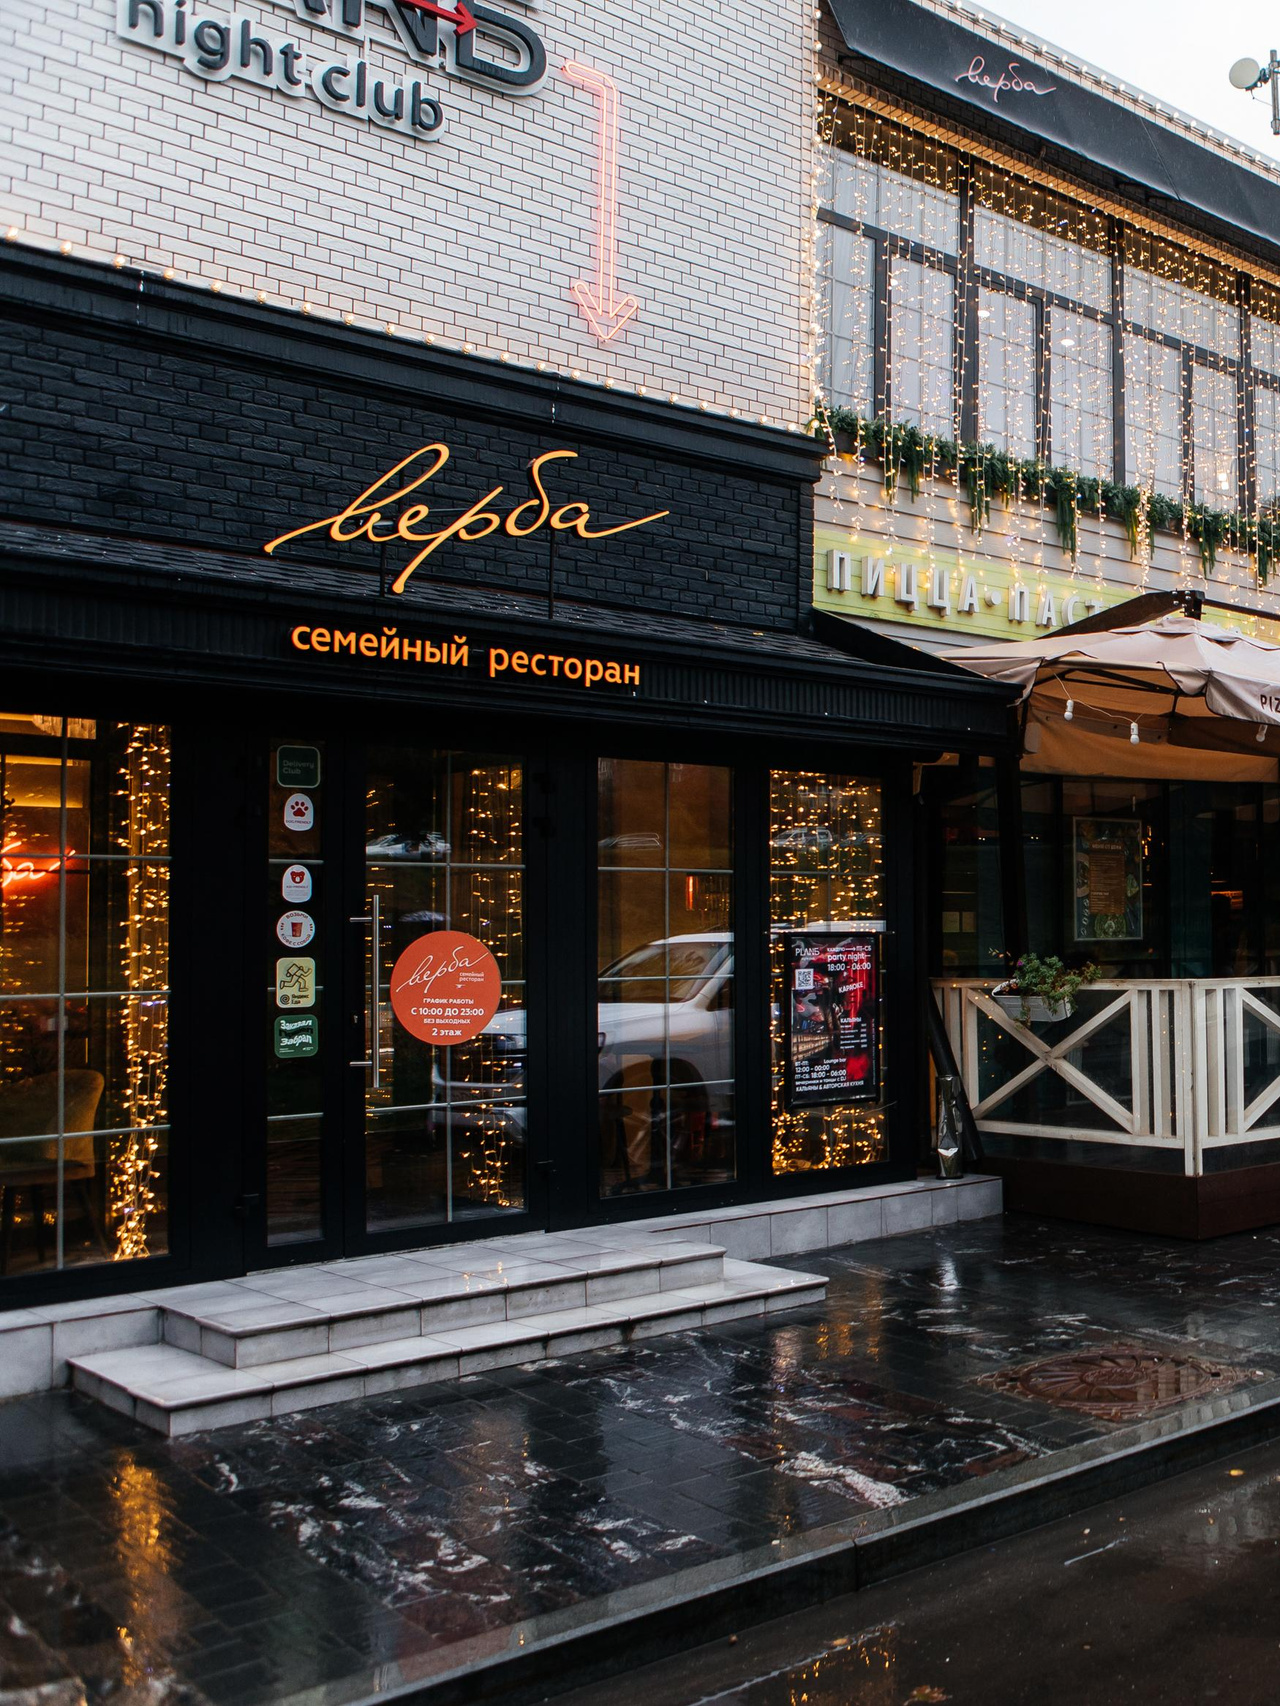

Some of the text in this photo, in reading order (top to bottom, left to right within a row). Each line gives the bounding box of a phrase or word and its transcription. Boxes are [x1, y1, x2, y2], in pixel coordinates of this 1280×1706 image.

[129, 0, 443, 131] night club
[827, 549, 980, 617] ПИЦЦА
[291, 625, 641, 687] семейный ресторан
[827, 951, 866, 962] party night
[827, 962, 872, 972] 18:00 06:00
[838, 981, 864, 993] КАРАОКЕ
[411, 1007, 485, 1017] С 10:00 ДО 23:00
[432, 1028, 438, 1036] 2
